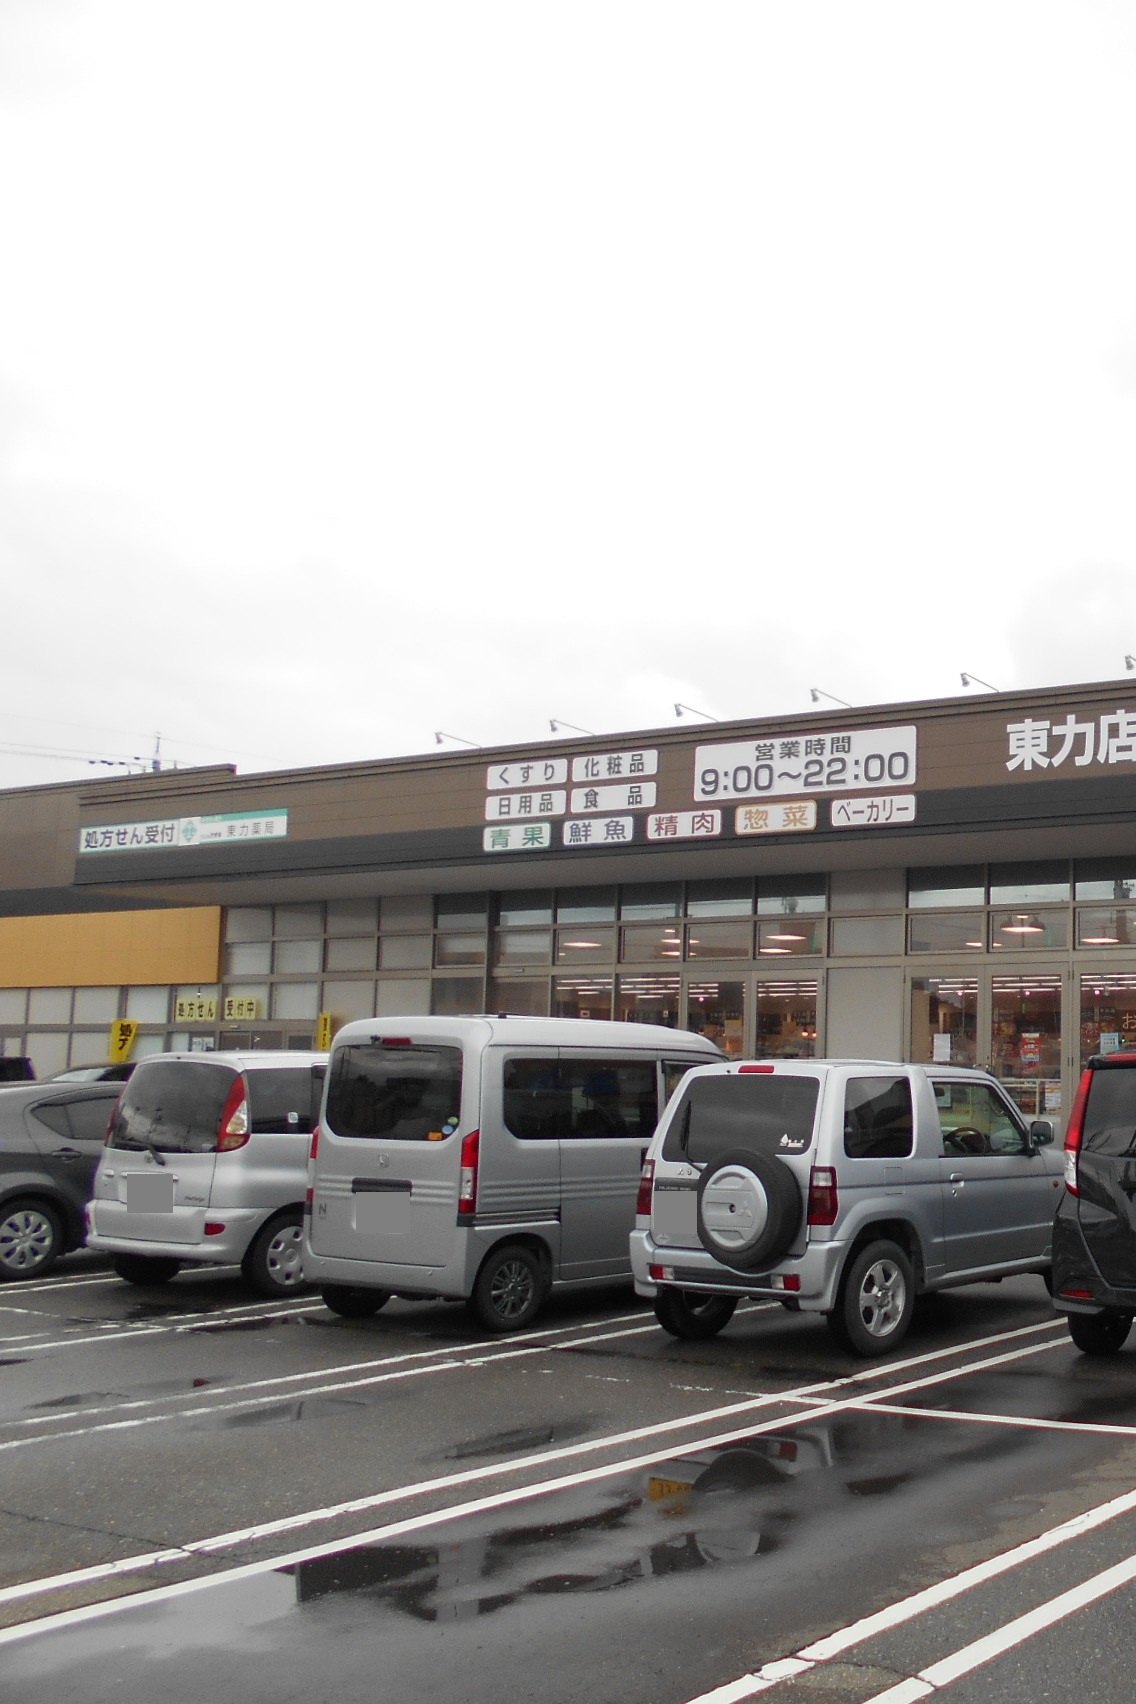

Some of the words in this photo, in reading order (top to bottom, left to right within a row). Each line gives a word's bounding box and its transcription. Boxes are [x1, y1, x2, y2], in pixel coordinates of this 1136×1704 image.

[754, 735, 852, 762] 営業時間
[498, 763, 556, 785] くすり
[583, 754, 645, 778] 化粧品
[498, 792, 554, 815] 日用品
[837, 801, 909, 823] ベーカリー
[654, 812, 715, 836] 精肉
[743, 805, 809, 830] 惣菜
[84, 823, 175, 849] 処方せん受付
[490, 825, 543, 849] 青果
[568, 818, 628, 843] 鮮魚
